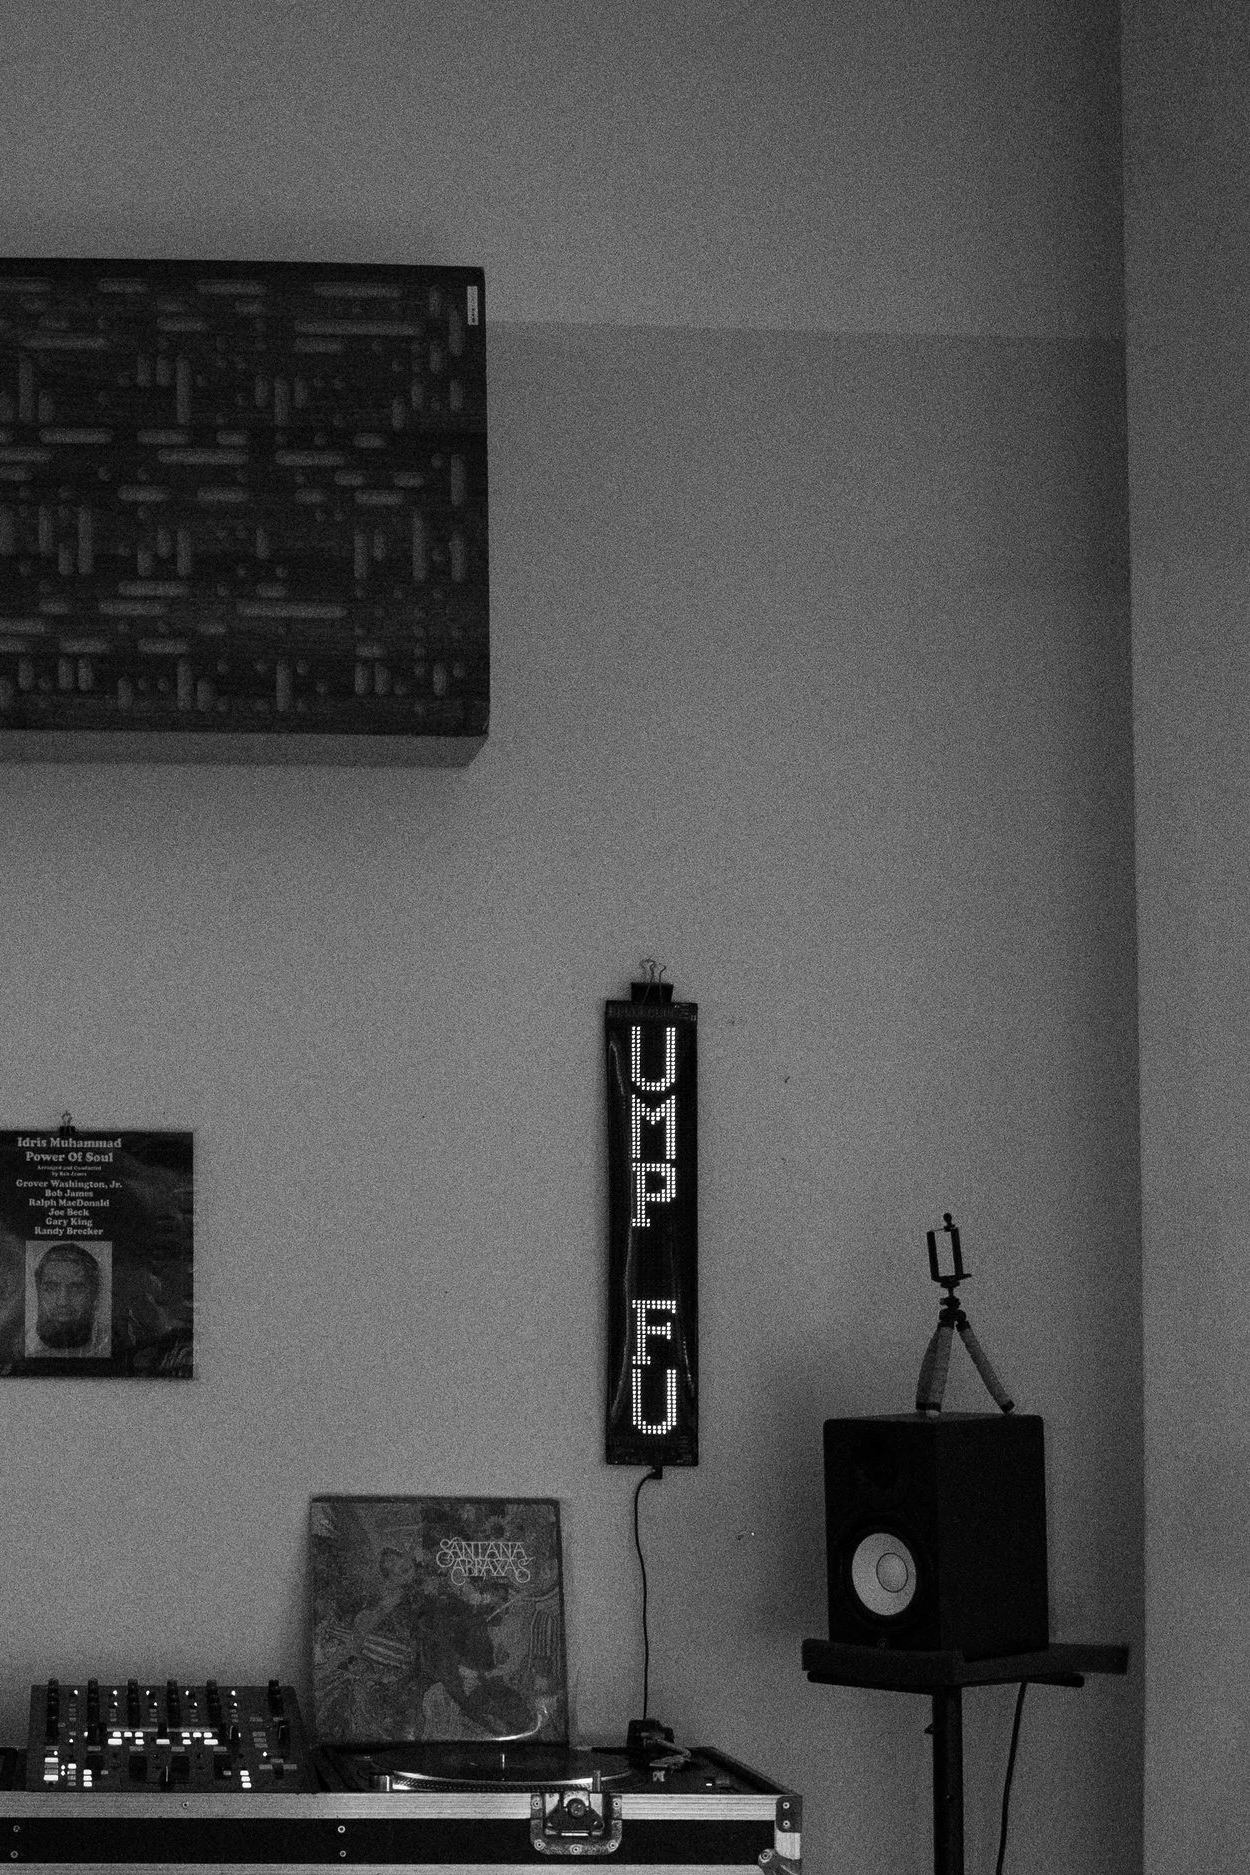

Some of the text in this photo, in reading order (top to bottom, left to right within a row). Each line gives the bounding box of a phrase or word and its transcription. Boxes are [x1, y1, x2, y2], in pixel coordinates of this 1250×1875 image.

[17, 1137, 122, 1148] Idris Muhammad
[25, 1151, 114, 1162] Power Of Soul
[15, 1179, 123, 1190] Grover Washington, Jr.
[45, 1189, 94, 1198] Bob James
[29, 1198, 110, 1208] Ralph MacDonald
[48, 1208, 90, 1216] Joe Beck
[45, 1217, 93, 1227] Gary King
[34, 1226, 104, 1237] Randy Brecker
[436, 1536, 528, 1568] SANTANA
